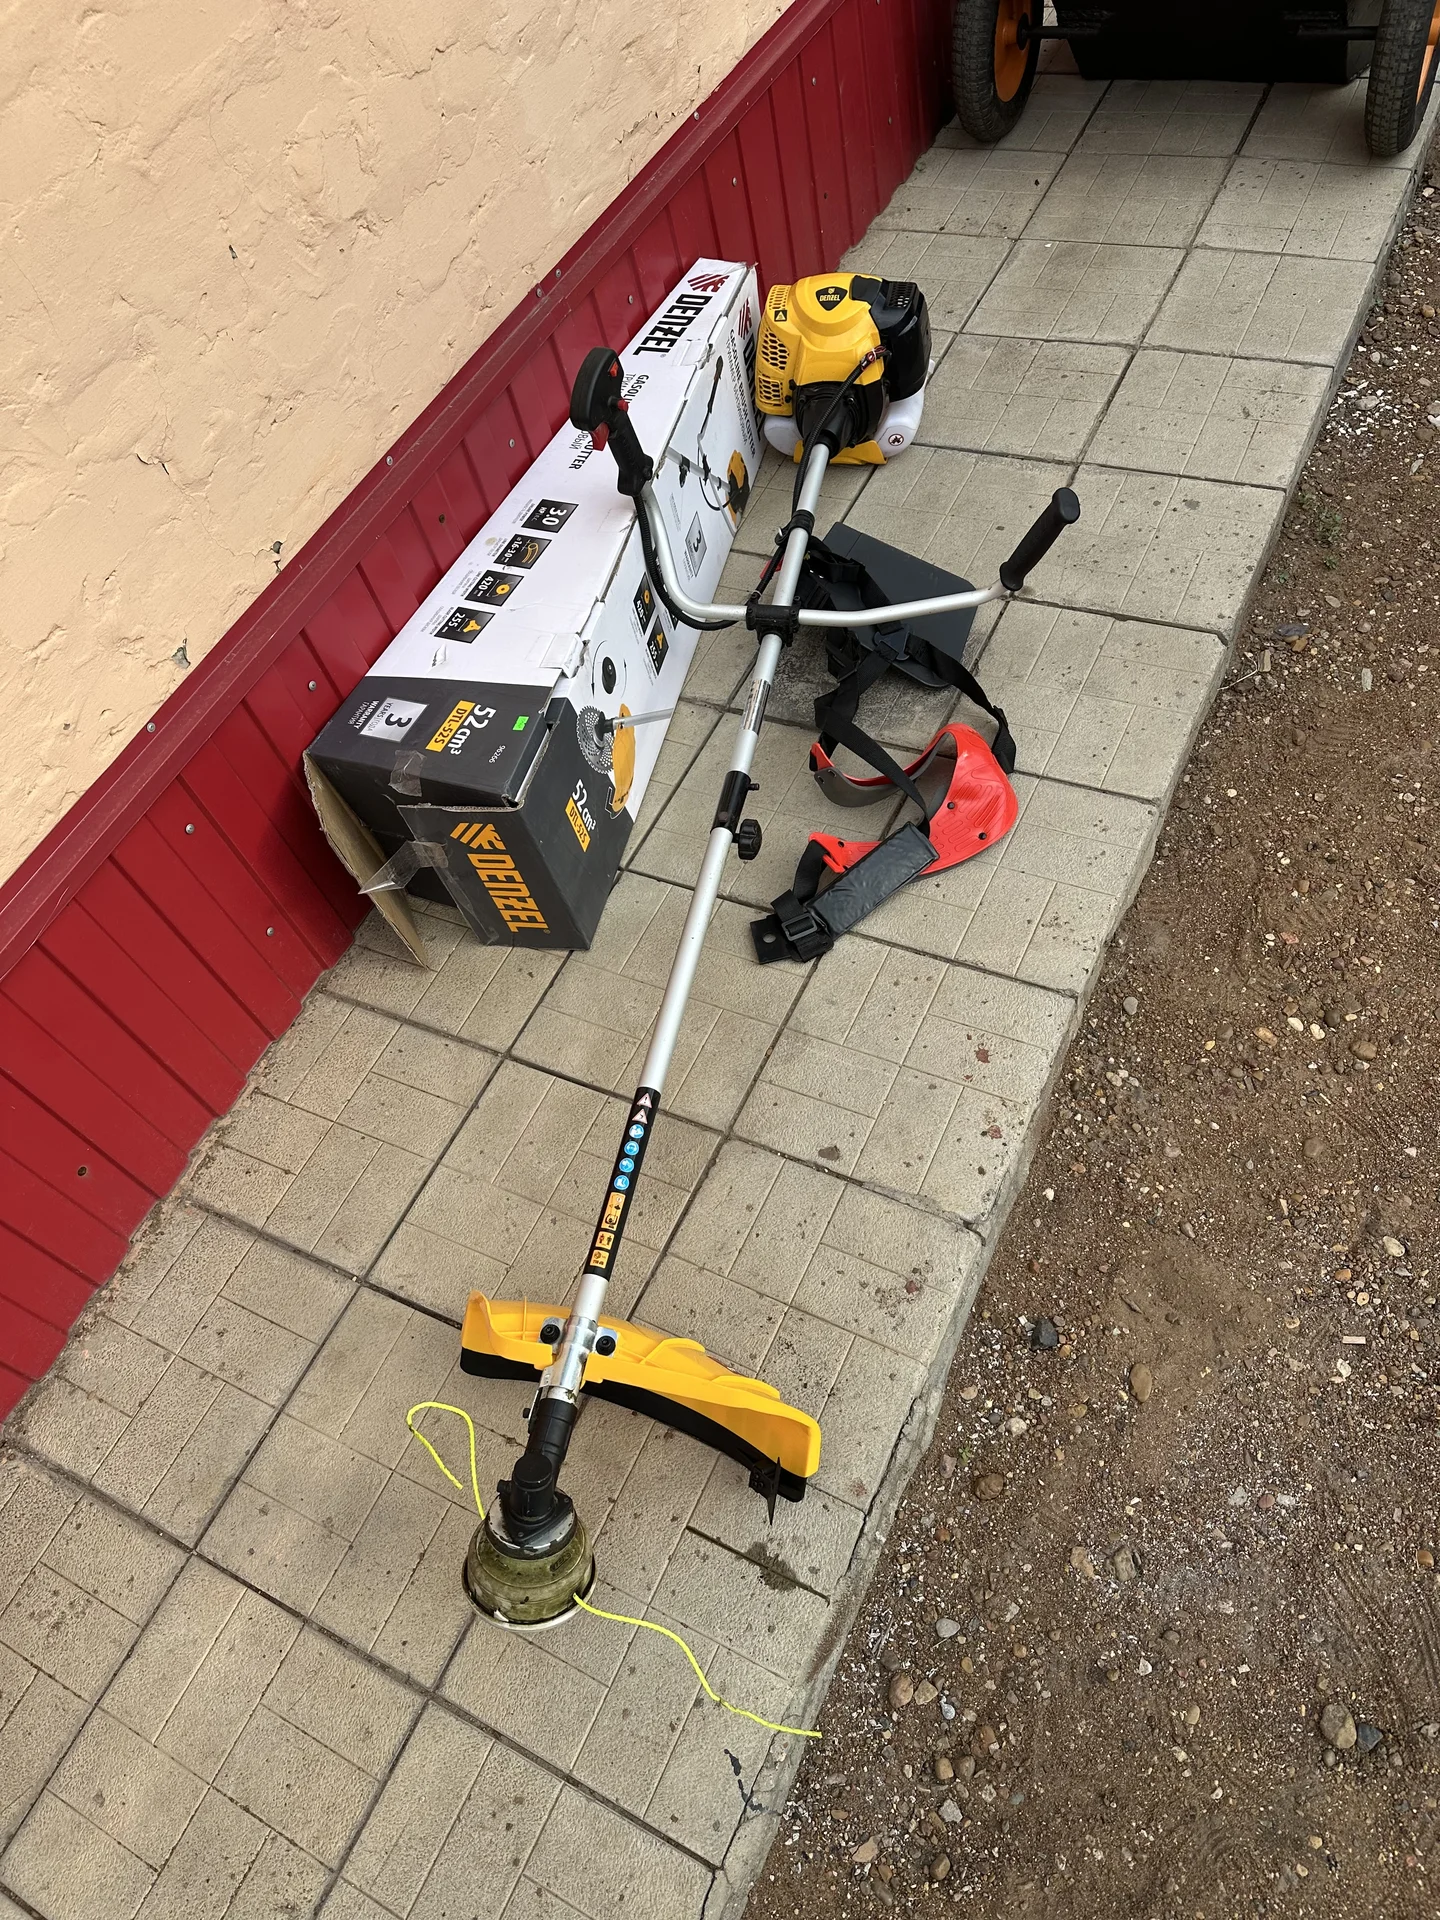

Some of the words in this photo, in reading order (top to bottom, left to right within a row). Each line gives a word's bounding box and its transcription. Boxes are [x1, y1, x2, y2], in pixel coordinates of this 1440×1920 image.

[633, 294, 713, 355] DENZEL
[542, 507, 567, 526] 3.0
[693, 530, 701, 552] 3
[478, 576, 494, 590] 420
[448, 612, 466, 627] 255
[353, 700, 379, 729] WARRANTY
[377, 702, 393, 718] YEARS
[385, 713, 412, 727] 3
[434, 708, 467, 744] DTL-52S
[489, 745, 505, 763] 96266
[570, 806, 587, 843] DTL-52S
[467, 853, 548, 932] DENZEL
